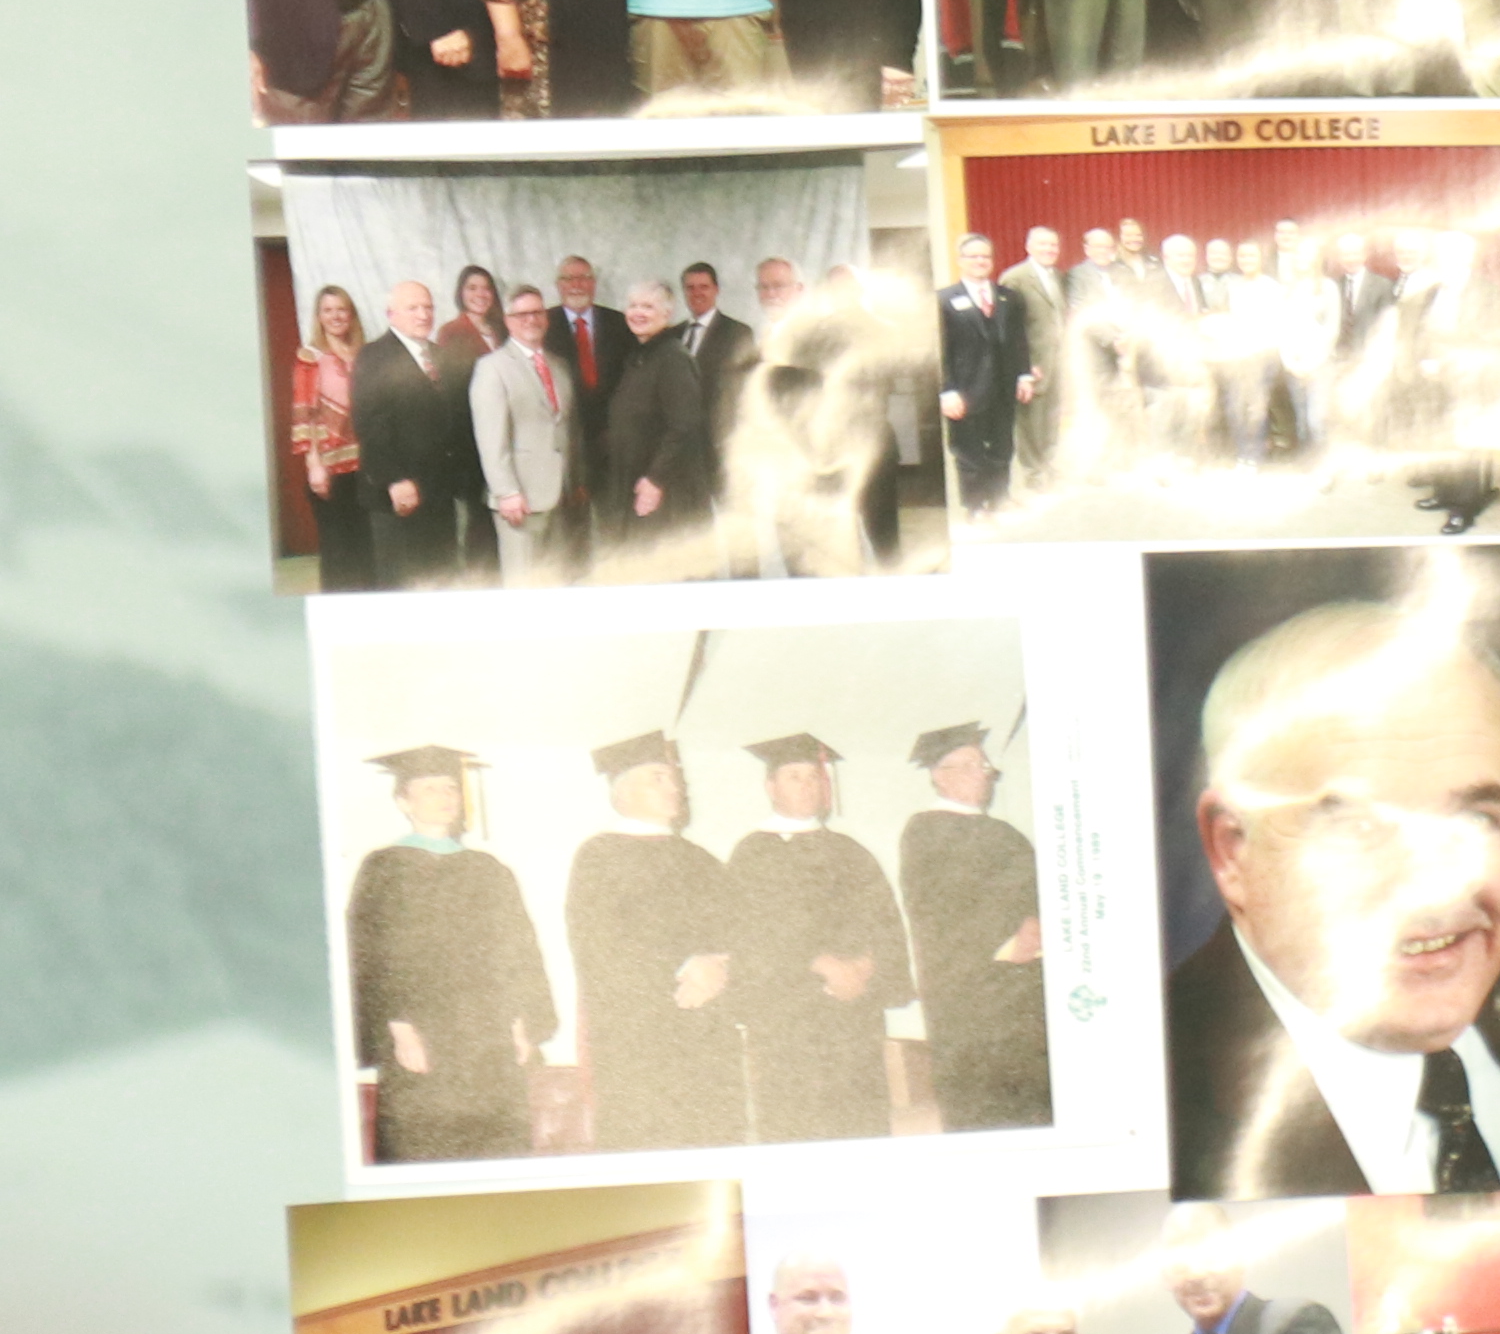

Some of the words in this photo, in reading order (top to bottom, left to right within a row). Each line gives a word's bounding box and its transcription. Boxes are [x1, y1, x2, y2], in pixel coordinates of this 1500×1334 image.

[1091, 124, 1155, 147] LAKE
[1169, 120, 1243, 144] LAND
[1255, 117, 1381, 142] COLLEGE
[1053, 803, 1068, 868] COLLEGE
[1057, 873, 1071, 911] LAND
[1059, 916, 1074, 954] LAKE
[383, 1297, 441, 1332] LAKE
[451, 1279, 527, 1316] LAND
